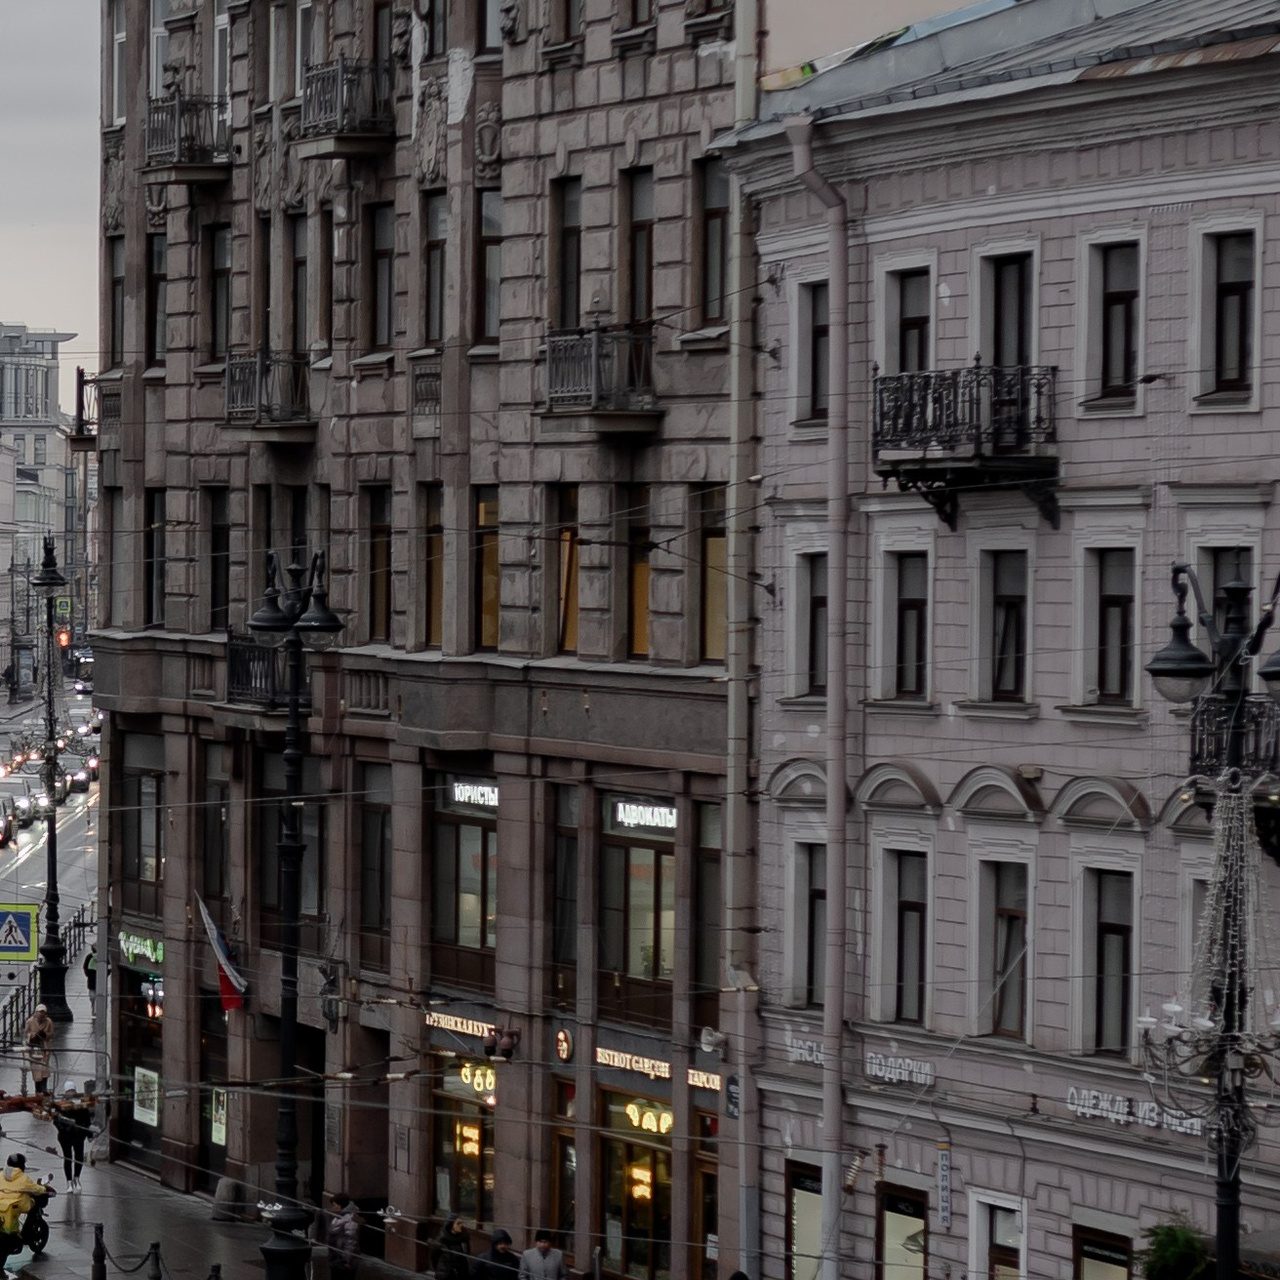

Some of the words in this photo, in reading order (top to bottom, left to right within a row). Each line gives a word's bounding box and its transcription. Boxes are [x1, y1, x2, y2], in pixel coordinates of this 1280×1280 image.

[453, 783, 500, 806] ЮРИСТЫ
[617, 802, 678, 829] АДВОКАТЫ
[596, 1047, 632, 1071] BISTROT
[866, 1052, 935, 1085] ПОДАРКИ
[1138, 1102, 1159, 1127] ИЗ
[940, 1152, 950, 1225] ПОЛИЦИЯ
